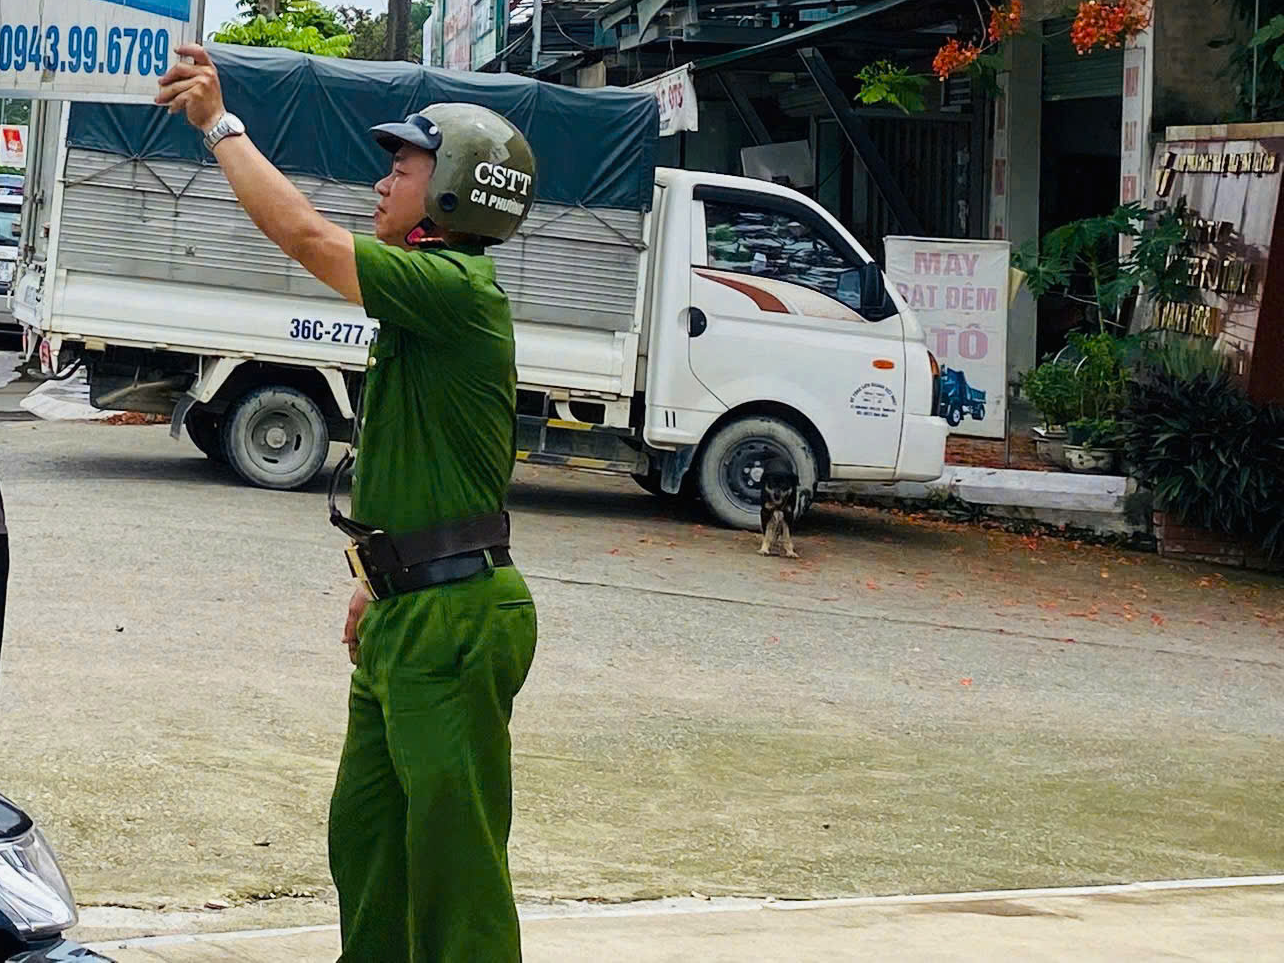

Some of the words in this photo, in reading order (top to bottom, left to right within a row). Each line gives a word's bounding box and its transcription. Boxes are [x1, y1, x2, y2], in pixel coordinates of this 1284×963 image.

[474, 162, 532, 196] CSTT
[470, 188, 487, 205] CA
[913, 251, 981, 278] MAY
